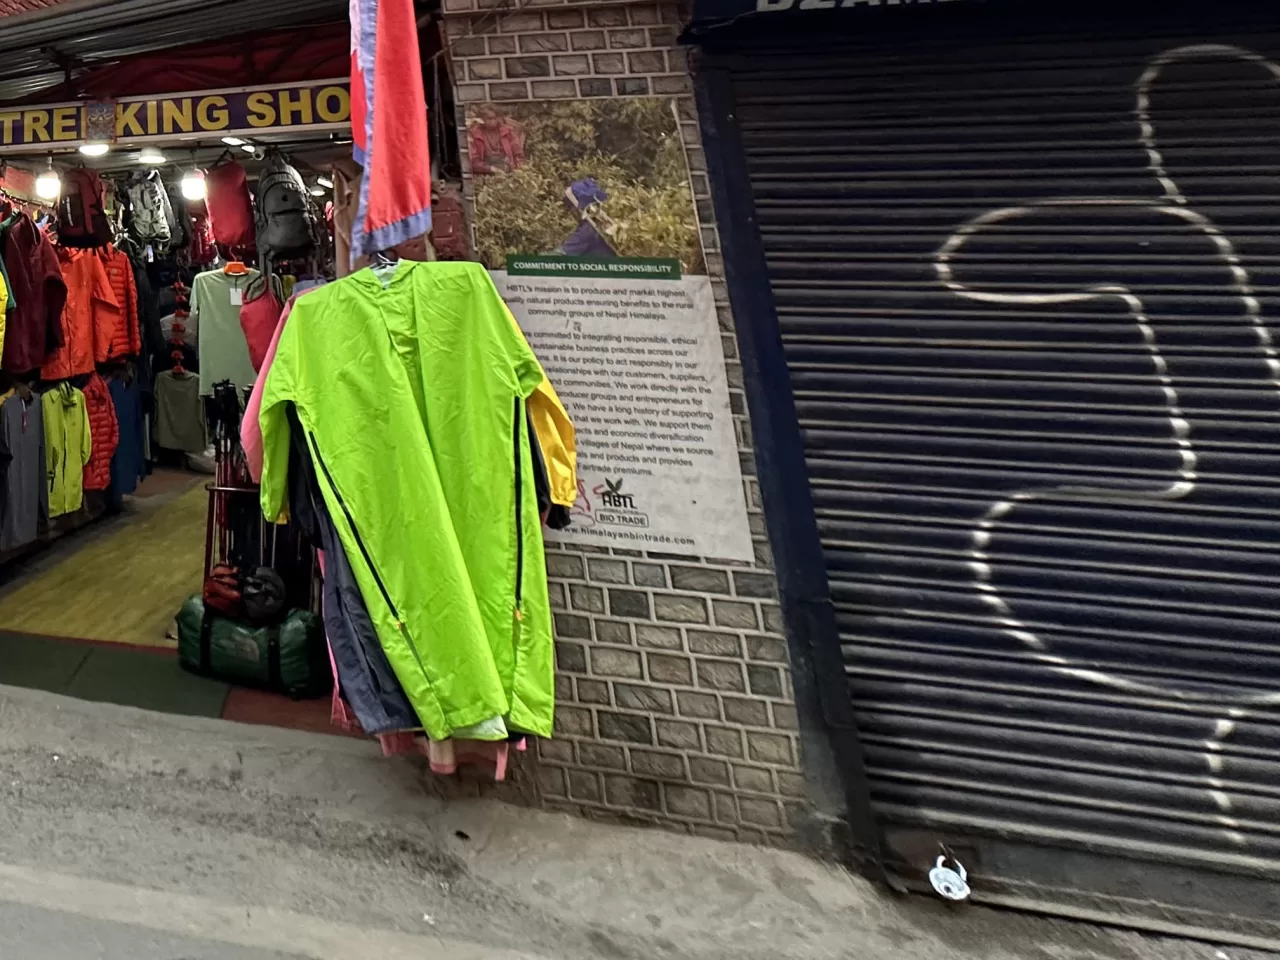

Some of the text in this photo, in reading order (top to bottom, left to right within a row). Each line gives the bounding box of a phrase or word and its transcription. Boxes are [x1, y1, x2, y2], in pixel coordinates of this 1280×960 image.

[246, 86, 352, 128] SHO
[513, 262, 566, 270] COMMITMENT
[609, 264, 672, 273] RESPONSIBILITY
[535, 285, 561, 293] mission
[581, 287, 610, 296] produce
[553, 298, 585, 306] products
[586, 300, 618, 308] ensuring
[528, 308, 566, 317] community
[606, 311, 627, 319] Nepal
[534, 331, 571, 339] committed
[582, 333, 622, 342] integrating
[533, 343, 574, 351] sustainable
[576, 345, 609, 353] business
[611, 347, 645, 355] practices
[583, 357, 604, 365] policy
[629, 359, 672, 369] responsibly
[615, 381, 628, 389] We
[651, 384, 676, 392] directly
[591, 393, 617, 401] groups
[636, 395, 690, 405] entrepreneurs
[615, 405, 632, 415] long
[634, 407, 659, 416] history
[671, 409, 713, 419] supporting
[660, 421, 689, 429] support
[610, 430, 648, 439] economic
[650, 433, 703, 442] diversification
[581, 440, 609, 448] villages
[621, 442, 644, 451] Nepal
[606, 453, 640, 463] products
[659, 457, 692, 466] provides
[577, 463, 611, 472] Fairtrade
[599, 514, 645, 525] BIO TRADE
